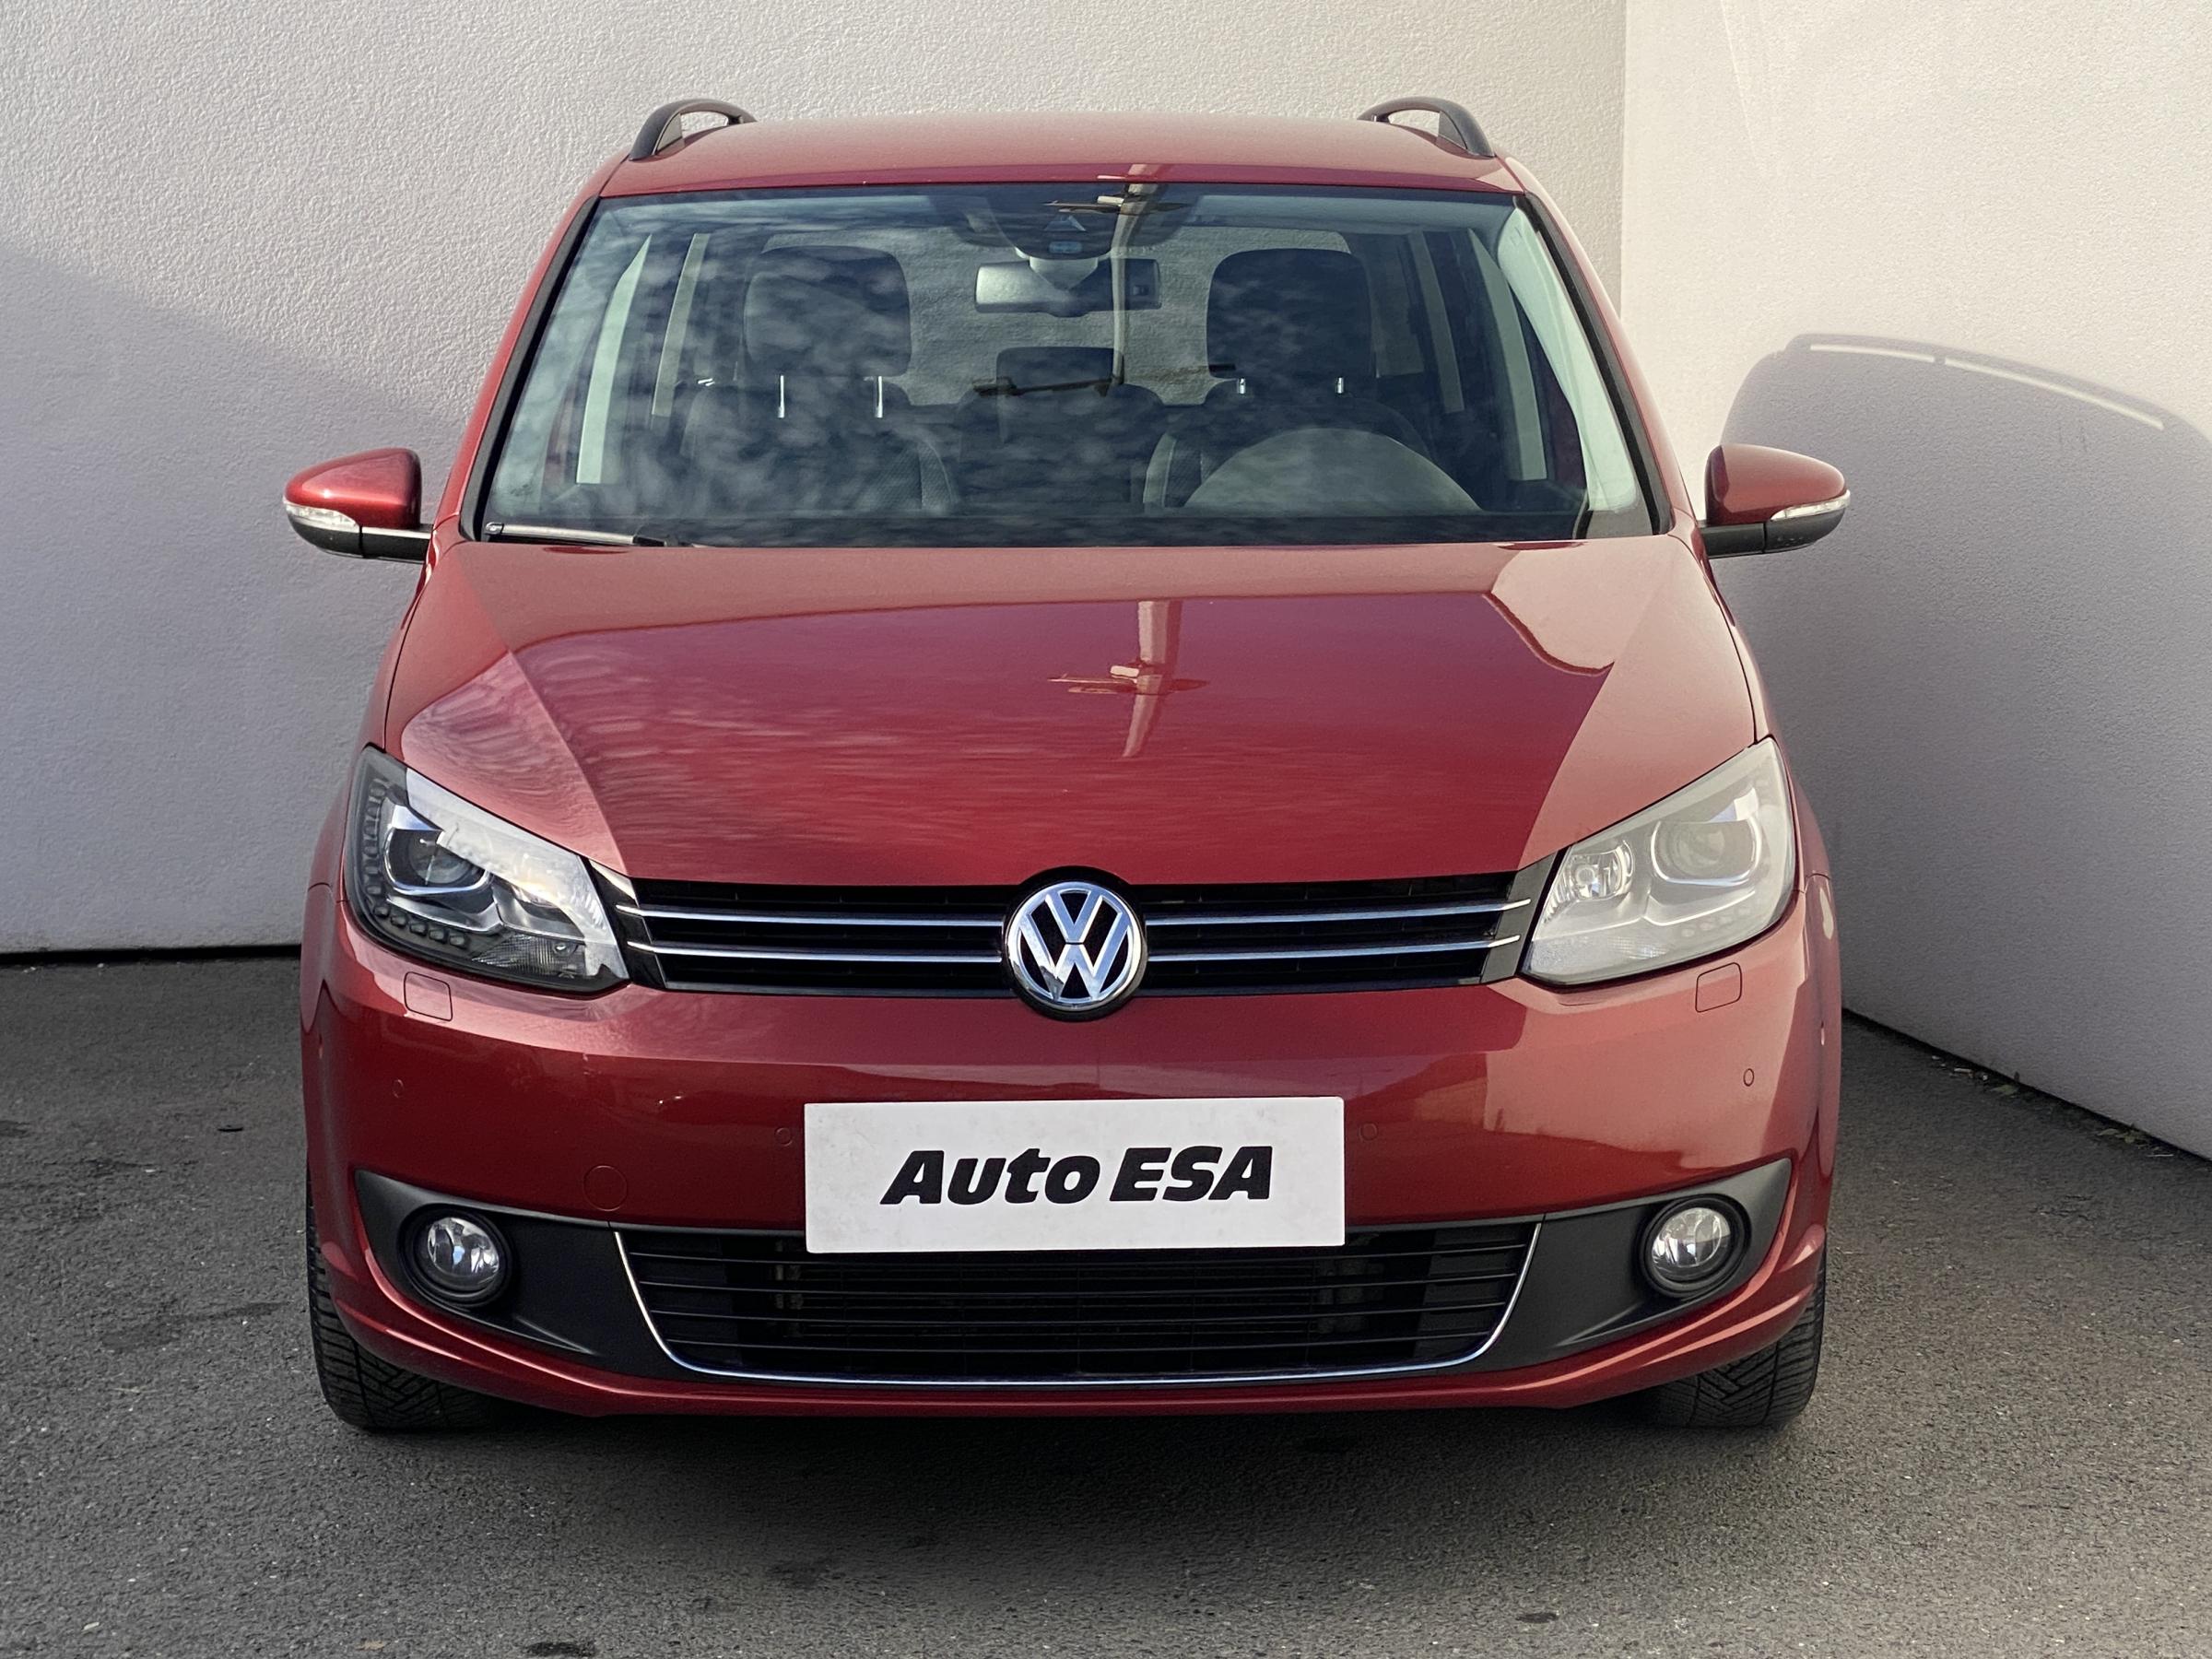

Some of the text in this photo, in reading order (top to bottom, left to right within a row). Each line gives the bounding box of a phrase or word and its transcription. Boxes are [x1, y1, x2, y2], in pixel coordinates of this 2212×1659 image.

[1012, 885, 1137, 1005] VW
[879, 1145, 1273, 1206] Auto ESA
